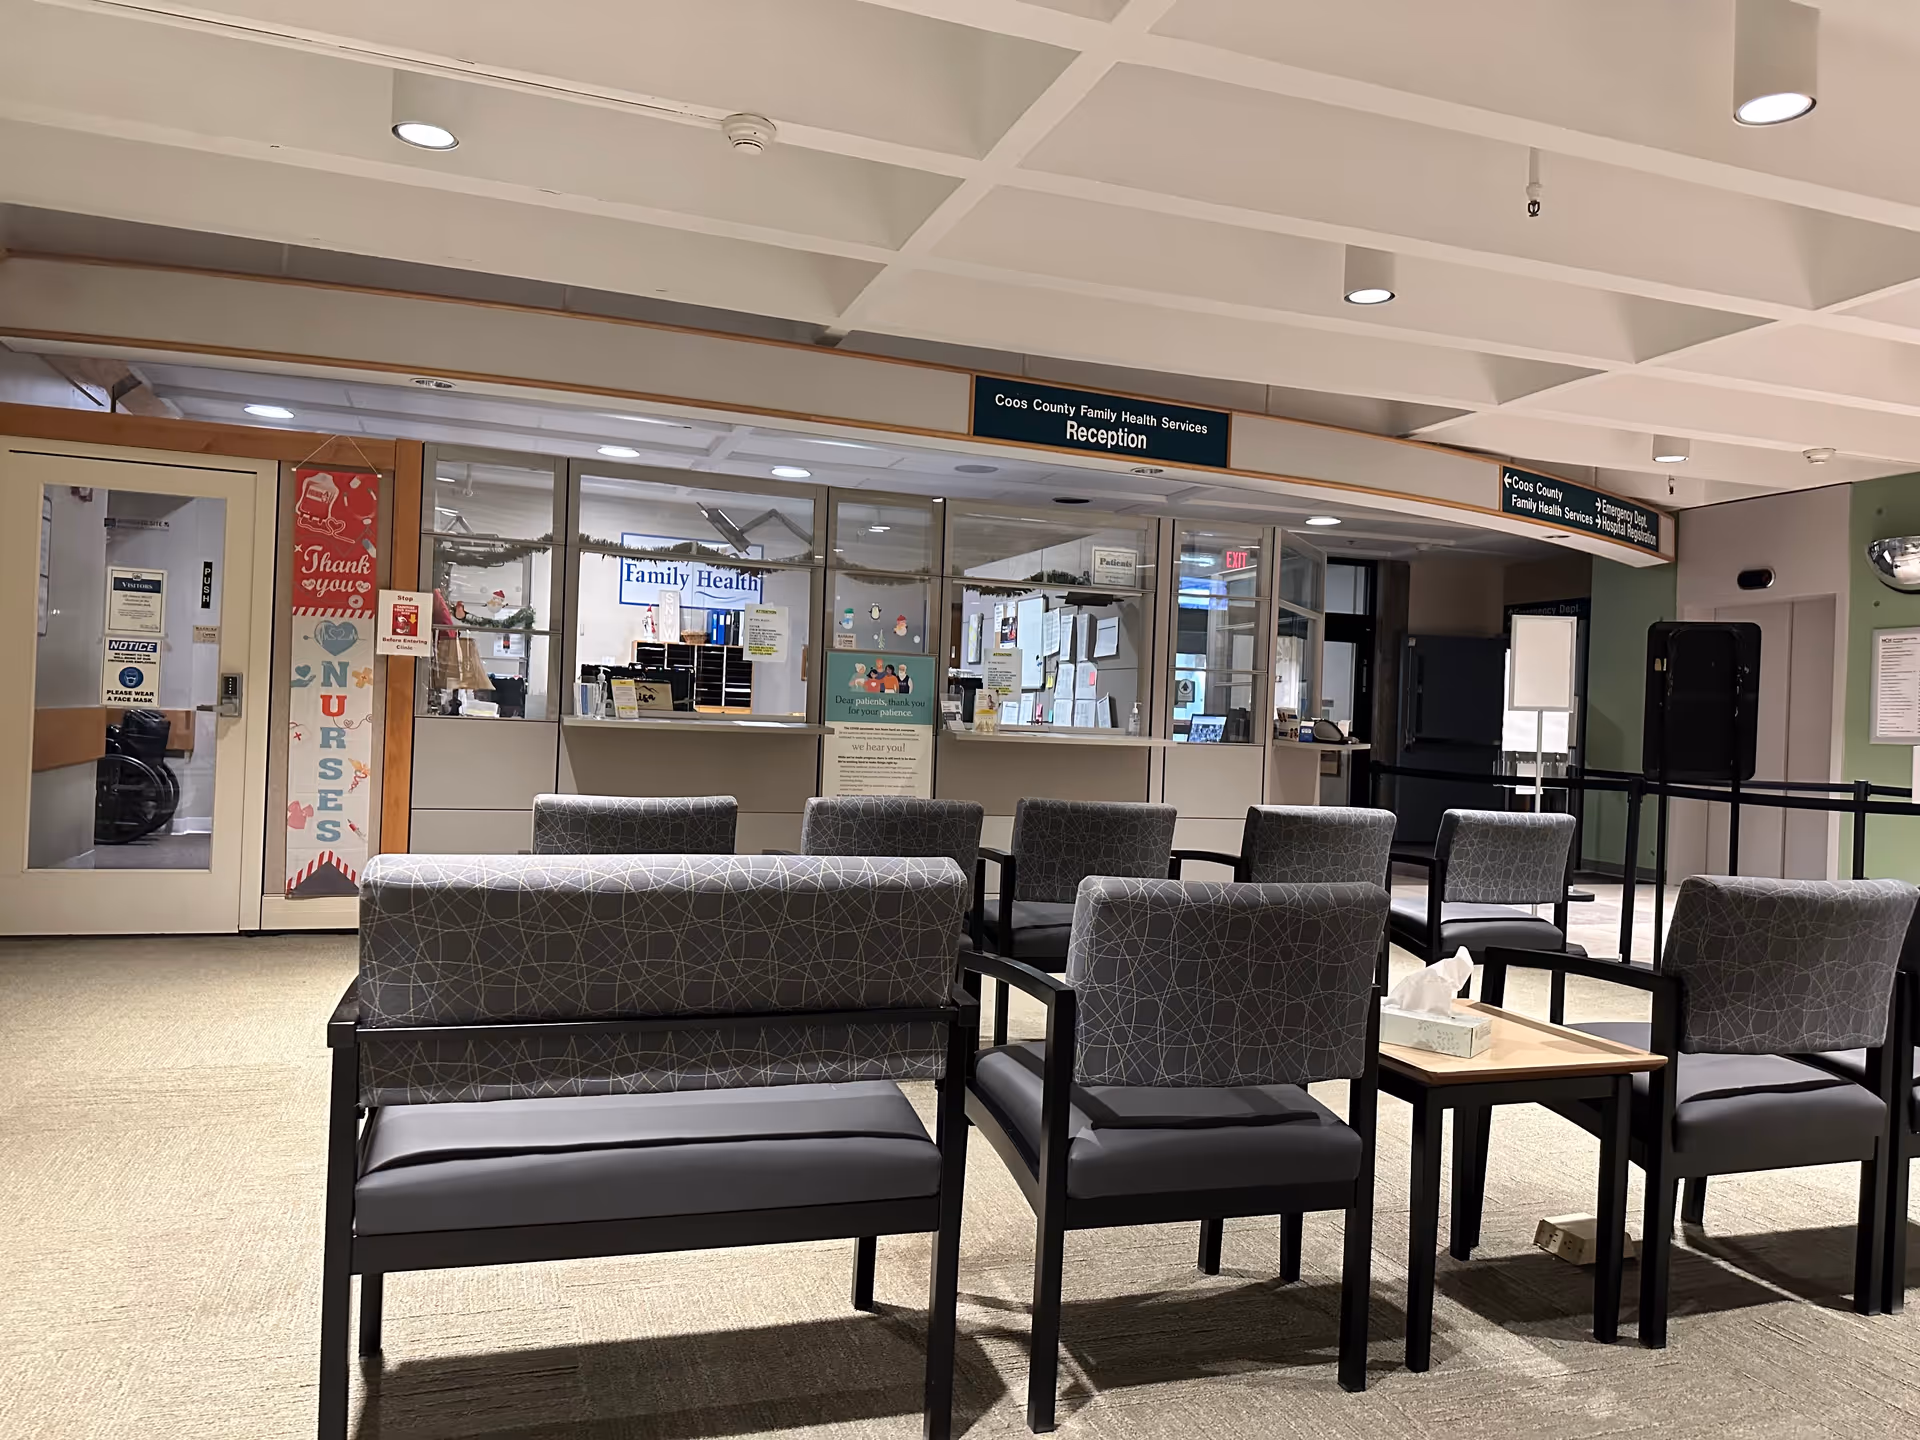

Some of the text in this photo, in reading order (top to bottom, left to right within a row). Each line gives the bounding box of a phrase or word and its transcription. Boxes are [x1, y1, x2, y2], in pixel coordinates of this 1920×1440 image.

[995, 393, 1208, 434] Coos County Family Health Services
[1066, 420, 1147, 449] Reception
[1512, 476, 1563, 502] Coos County
[1511, 494, 1594, 525] Family Health Services
[1602, 499, 1648, 528] Emergency Dept.
[1602, 516, 1657, 547] Hospital Registration
[301, 545, 371, 574] Thank
[1099, 557, 1133, 568] Patients
[1226, 551, 1248, 569] EXIT
[121, 581, 153, 590] VISITORS
[202, 567, 211, 603] PUSH
[315, 578, 355, 597] you
[624, 562, 759, 592] Family Health
[397, 594, 414, 602] Stop
[664, 592, 675, 640] SNW
[110, 641, 156, 652] NOTICE
[636, 693, 656, 703] isa
[835, 695, 926, 709] Dear patients, thank you
[848, 706, 914, 717] for your patience.
[316, 660, 350, 842] NURSES
[851, 742, 906, 753] we hear you!
